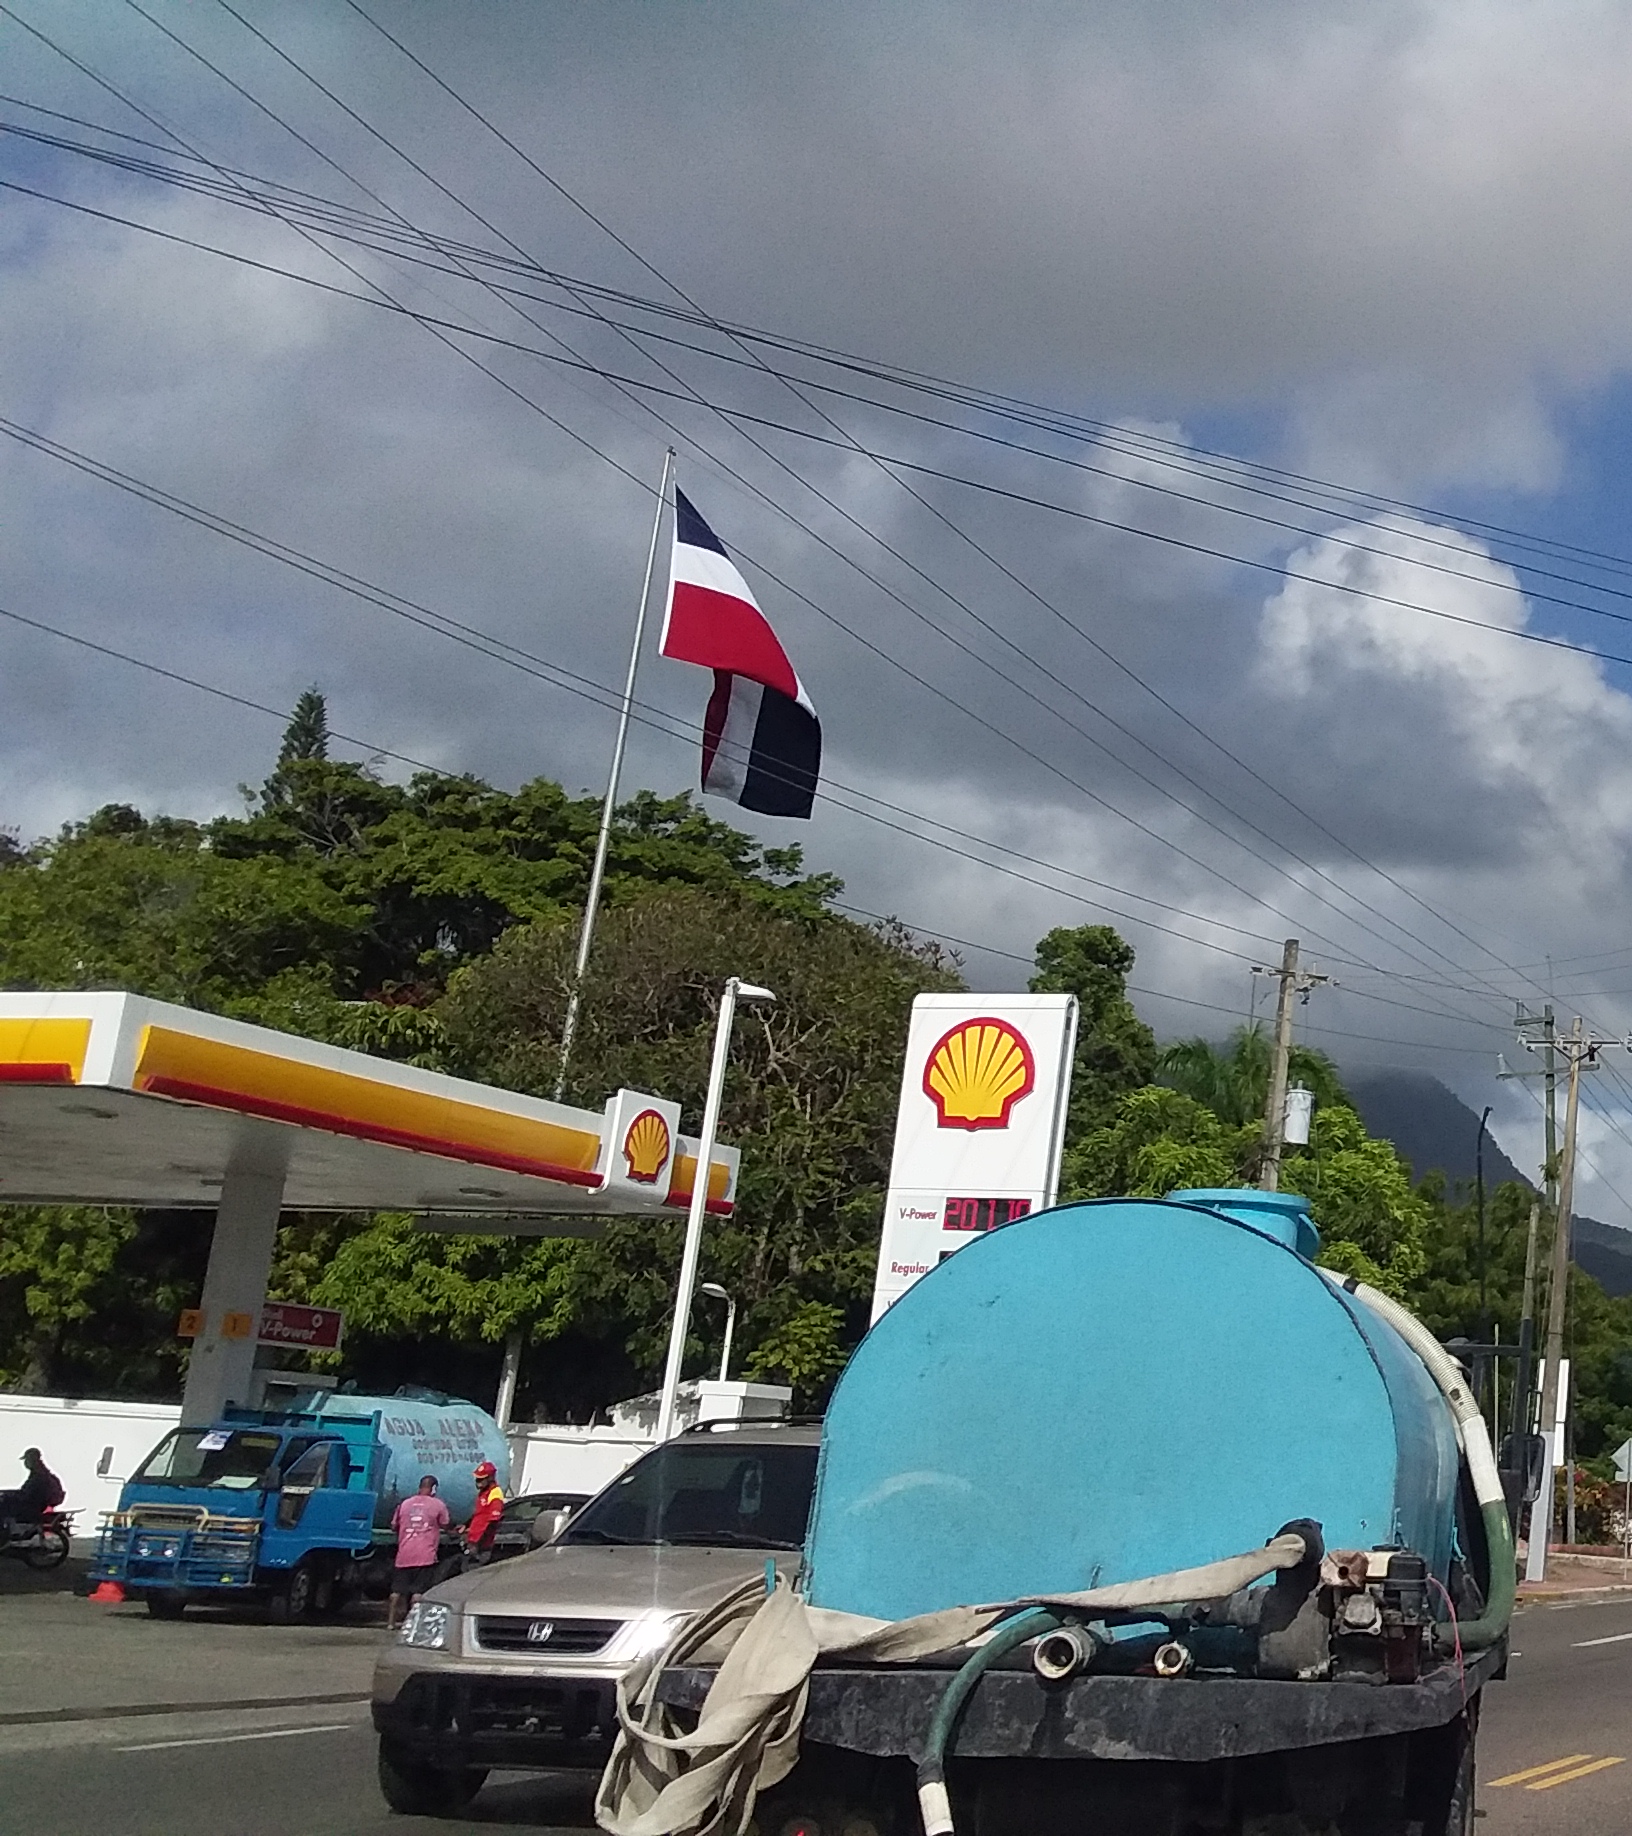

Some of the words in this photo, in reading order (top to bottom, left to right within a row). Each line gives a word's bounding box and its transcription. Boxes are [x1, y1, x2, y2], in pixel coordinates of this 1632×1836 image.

[899, 1207, 938, 1220] V-Power
[891, 1261, 930, 1276] Regular
[260, 1318, 317, 1341] V-Power
[384, 1417, 426, 1436] AGUA
